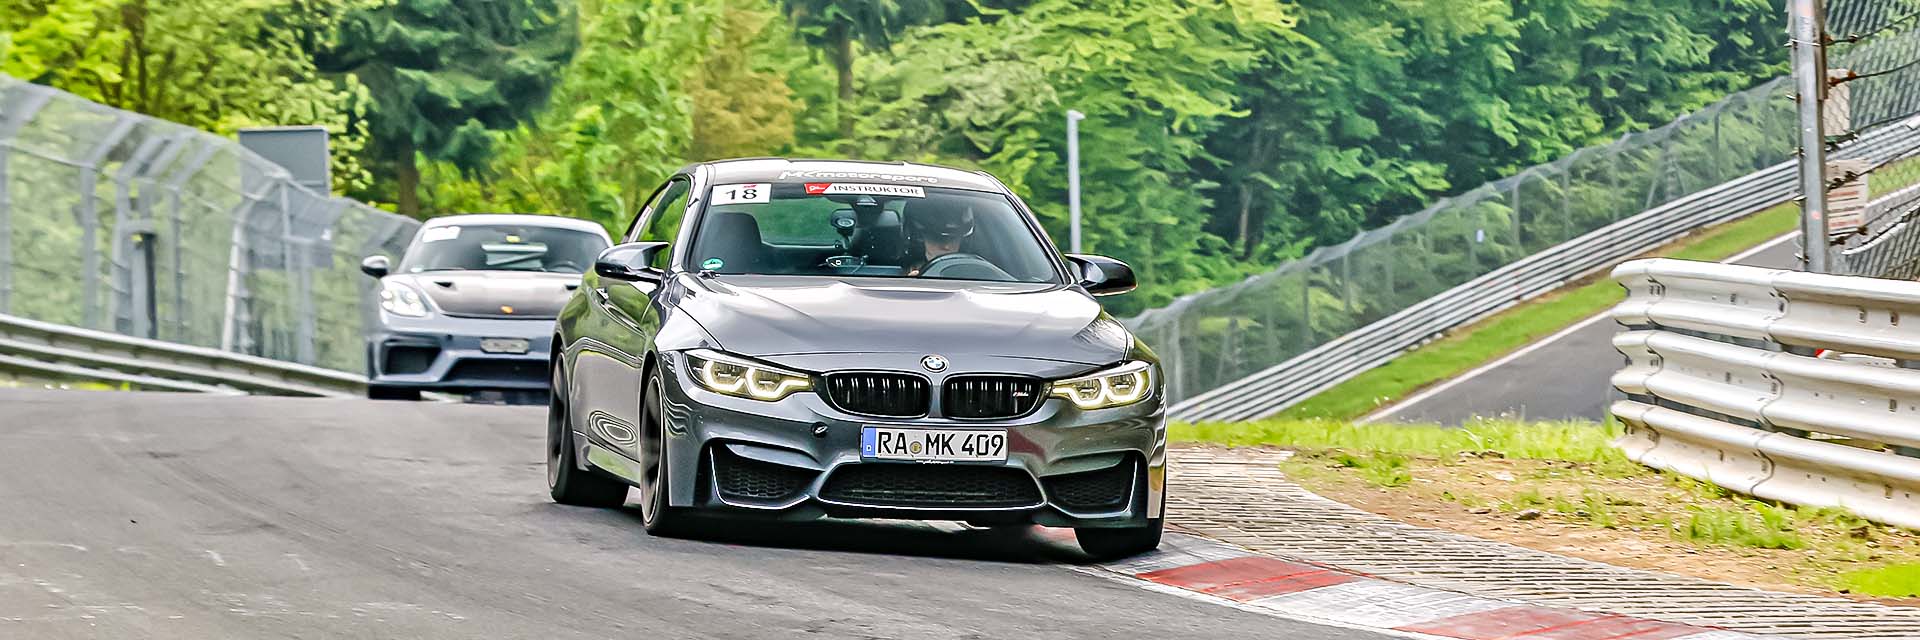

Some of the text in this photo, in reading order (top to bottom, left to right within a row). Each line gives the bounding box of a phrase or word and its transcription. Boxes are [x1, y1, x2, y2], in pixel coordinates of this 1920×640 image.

[725, 188, 757, 200] 18
[833, 185, 919, 195] INSTRUKTOR
[878, 431, 1004, 457] RA MK 409
